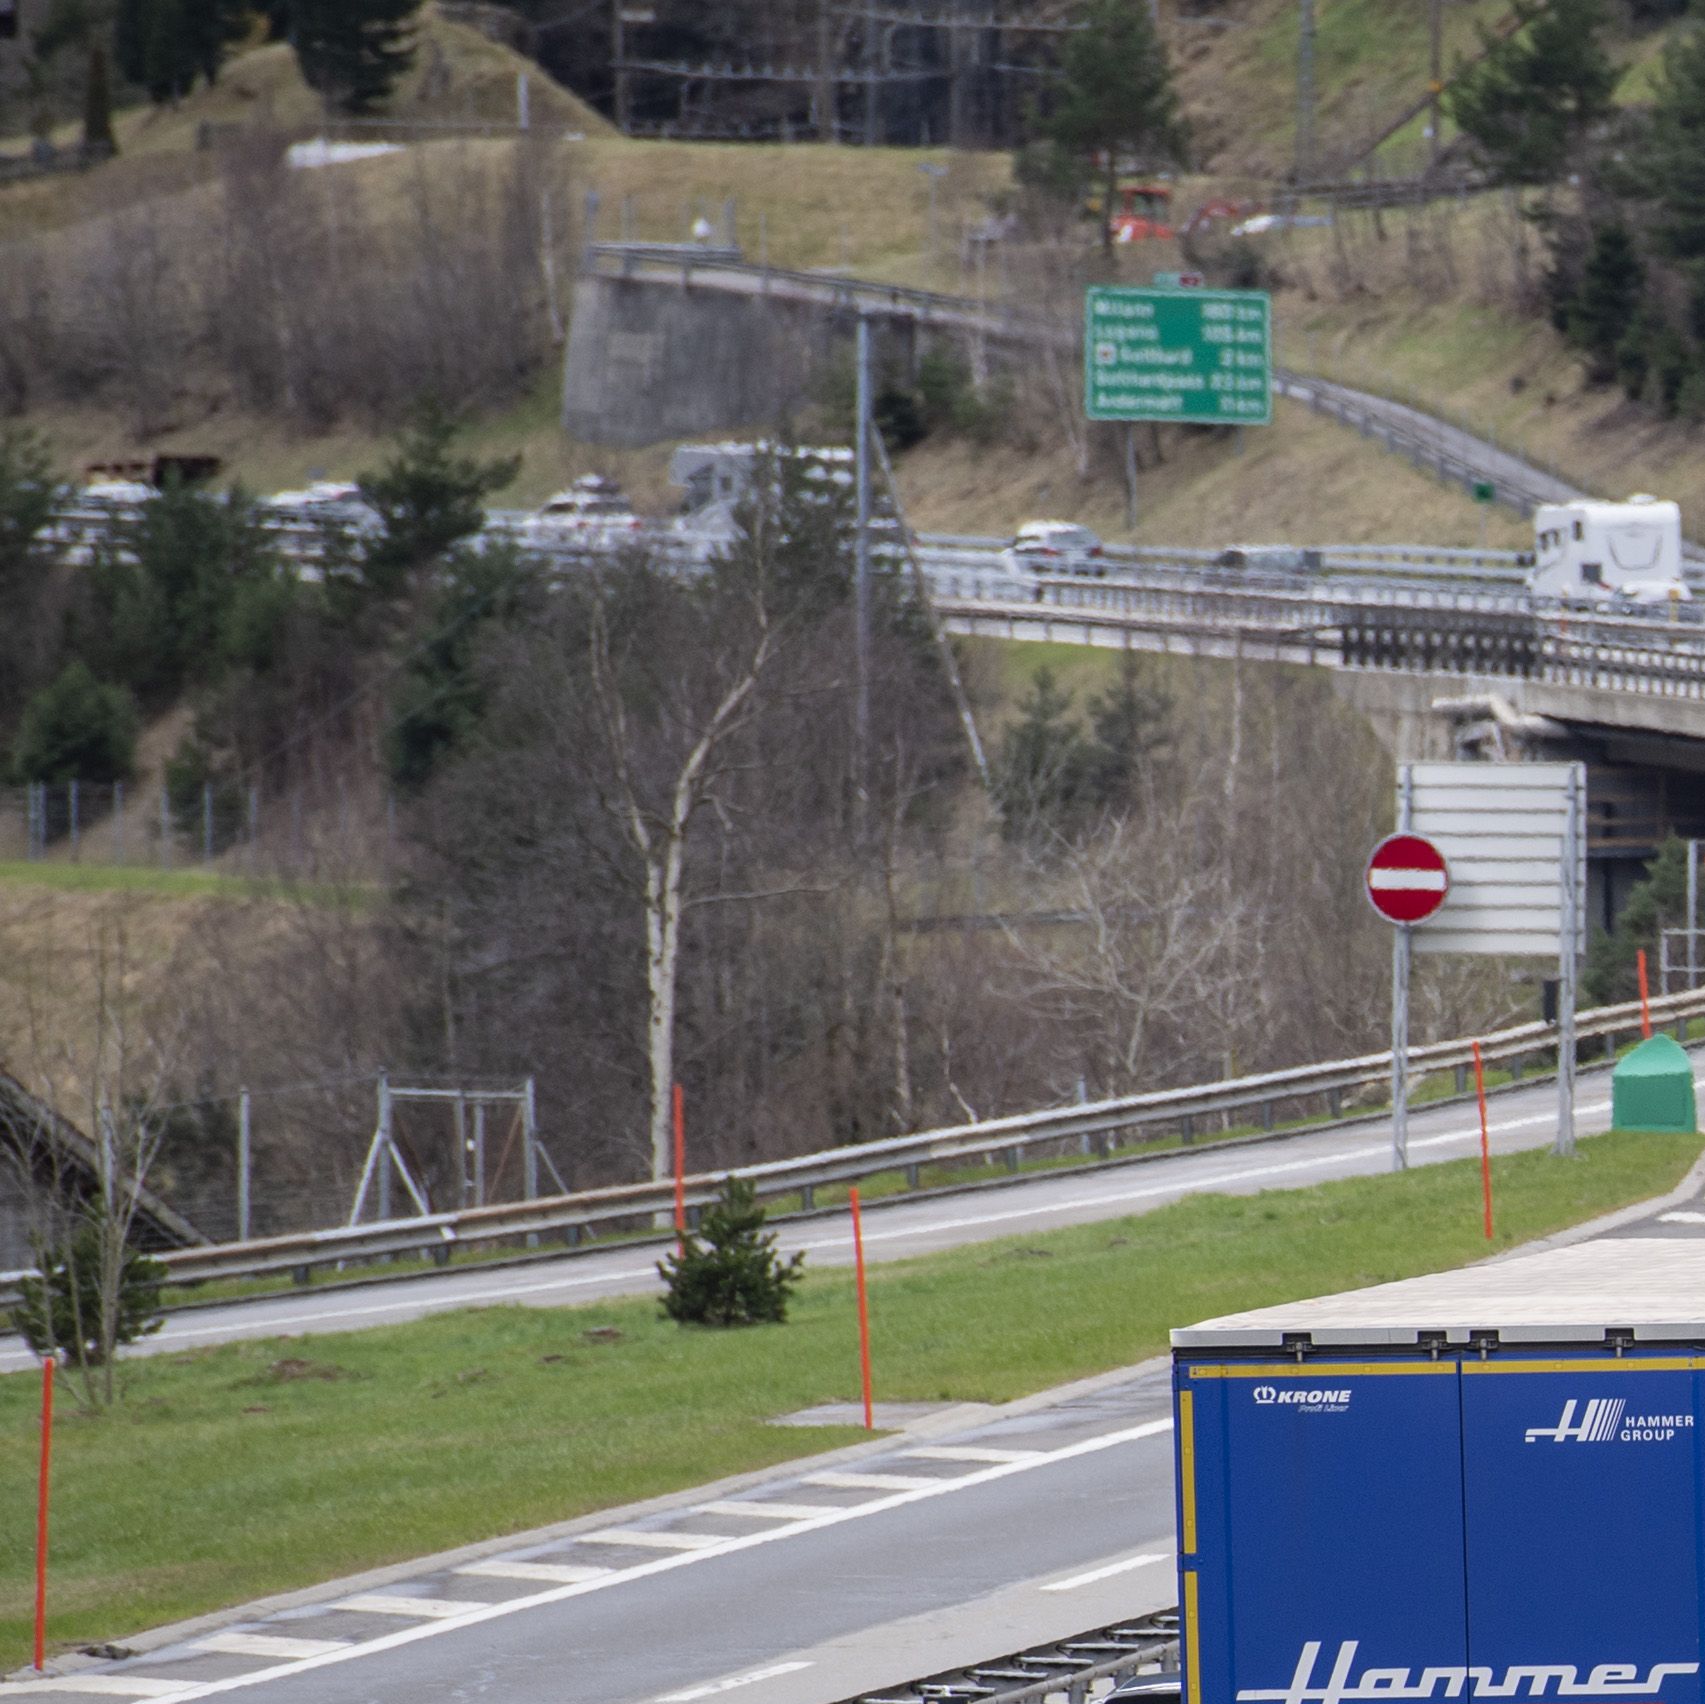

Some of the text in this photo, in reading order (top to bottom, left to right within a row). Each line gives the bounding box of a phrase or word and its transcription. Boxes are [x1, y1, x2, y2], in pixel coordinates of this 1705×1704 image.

[1278, 1389, 1351, 1404] KRONE
[1626, 1415, 1694, 1428] HAMMER
[1621, 1429, 1675, 1442] GROUP
